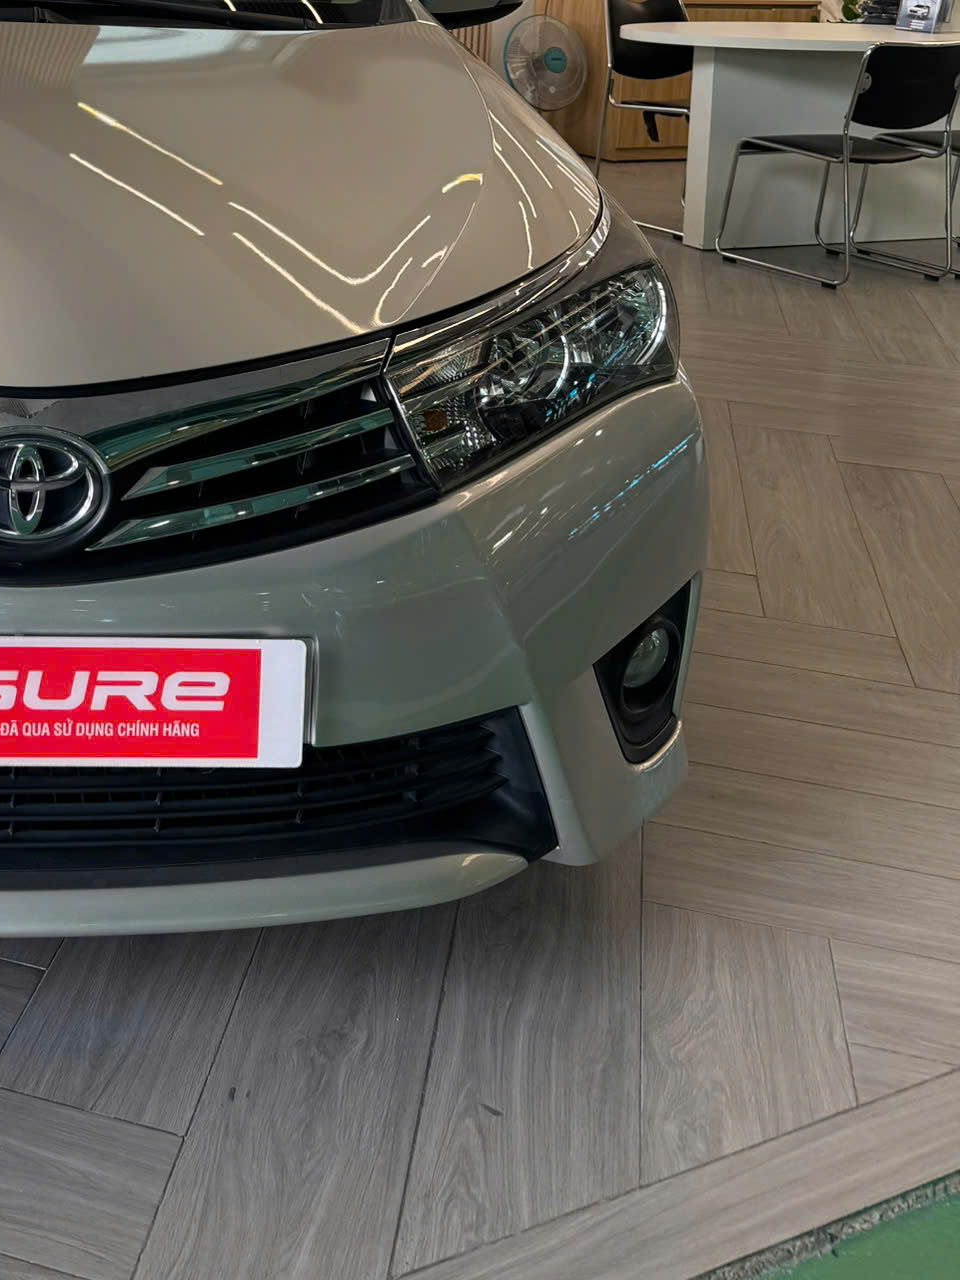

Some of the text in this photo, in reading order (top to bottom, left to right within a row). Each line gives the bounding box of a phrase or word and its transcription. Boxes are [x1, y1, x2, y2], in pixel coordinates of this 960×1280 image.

[0, 720, 19, 737] ĐÃ
[22, 722, 50, 737] QUA
[53, 718, 73, 737] SỬ
[76, 722, 114, 740] DỤNG
[117, 720, 160, 737] CHÍNH
[162, 720, 200, 737] HÃNG
